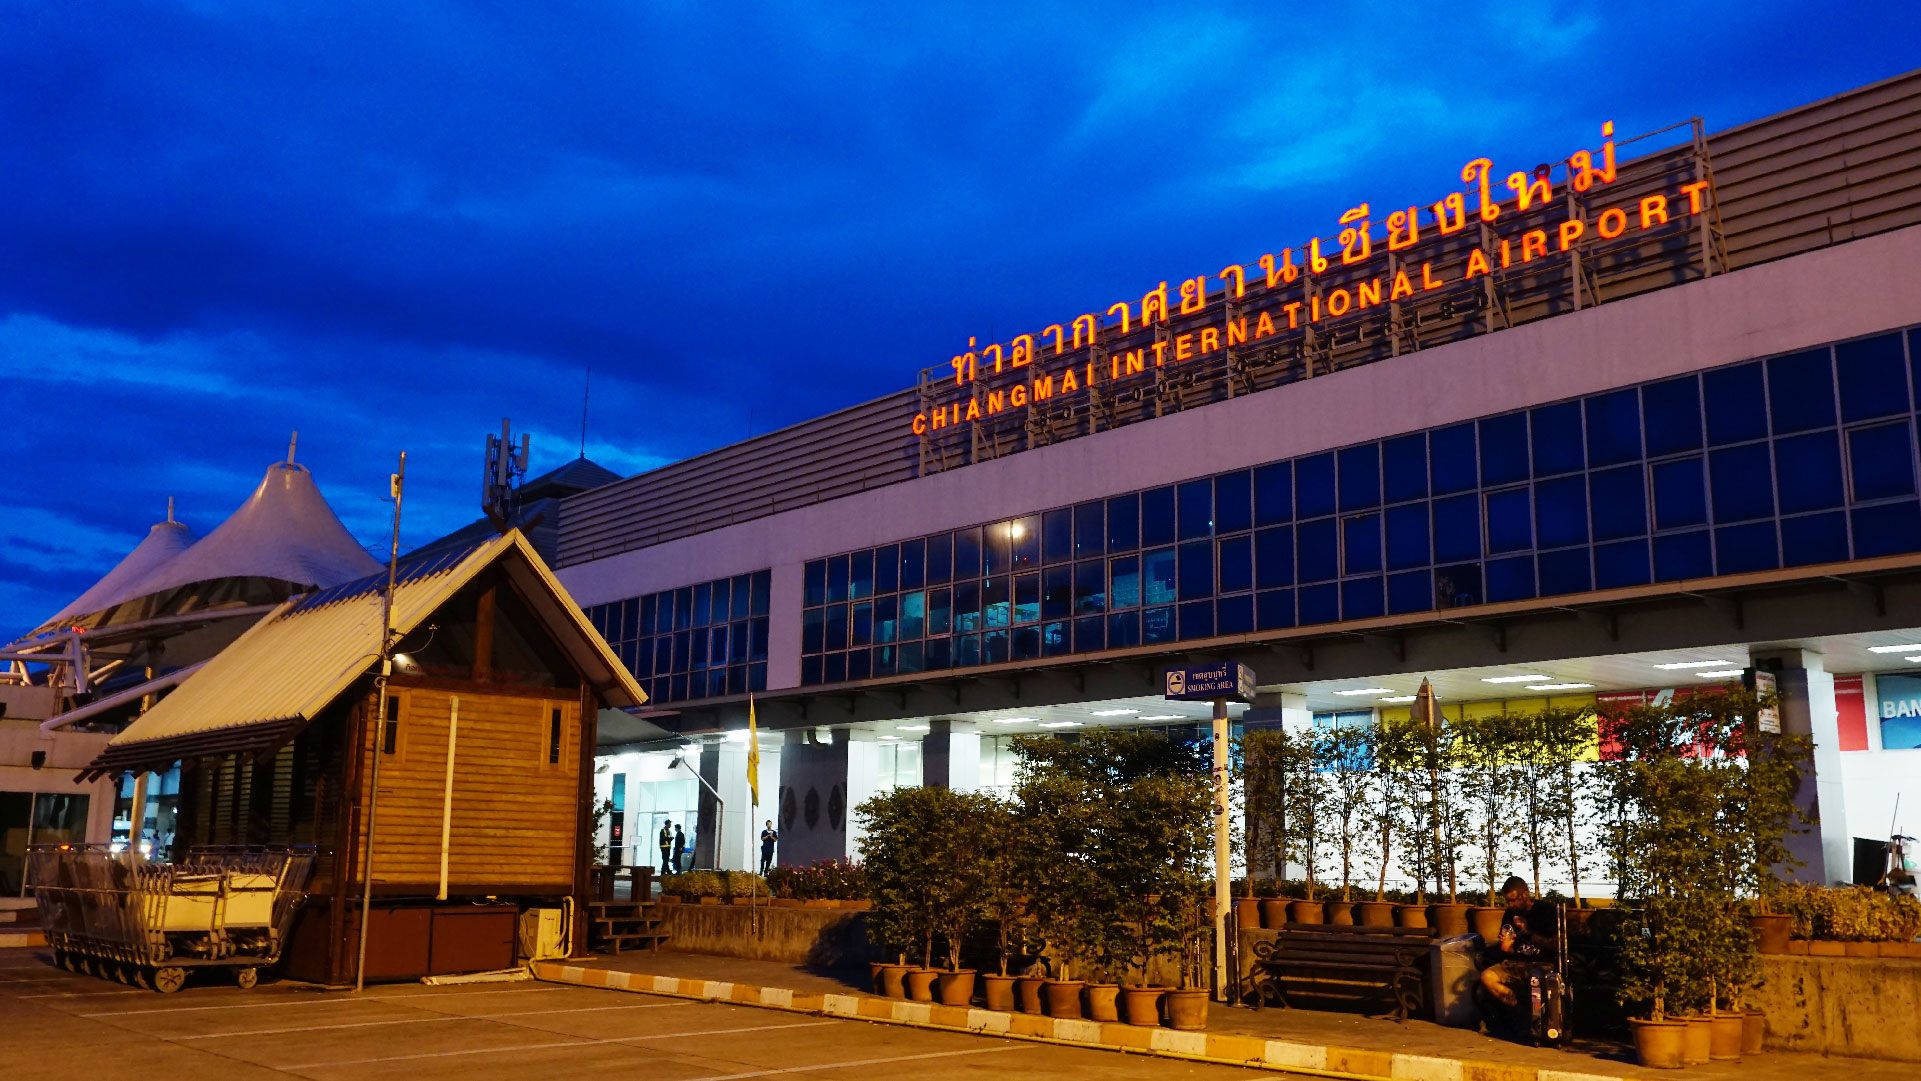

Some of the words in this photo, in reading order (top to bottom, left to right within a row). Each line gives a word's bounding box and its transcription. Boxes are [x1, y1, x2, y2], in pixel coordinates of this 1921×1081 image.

[911, 362, 1094, 435] CHIANGMAI
[1111, 262, 1444, 381] INTERNATIONAL
[1464, 180, 1708, 280] AIRPORT
[951, 119, 1616, 386] ท่าอากาศยานเชียงใหม่
[1187, 682, 1216, 693] SMOKING
[1216, 680, 1234, 690] AREA
